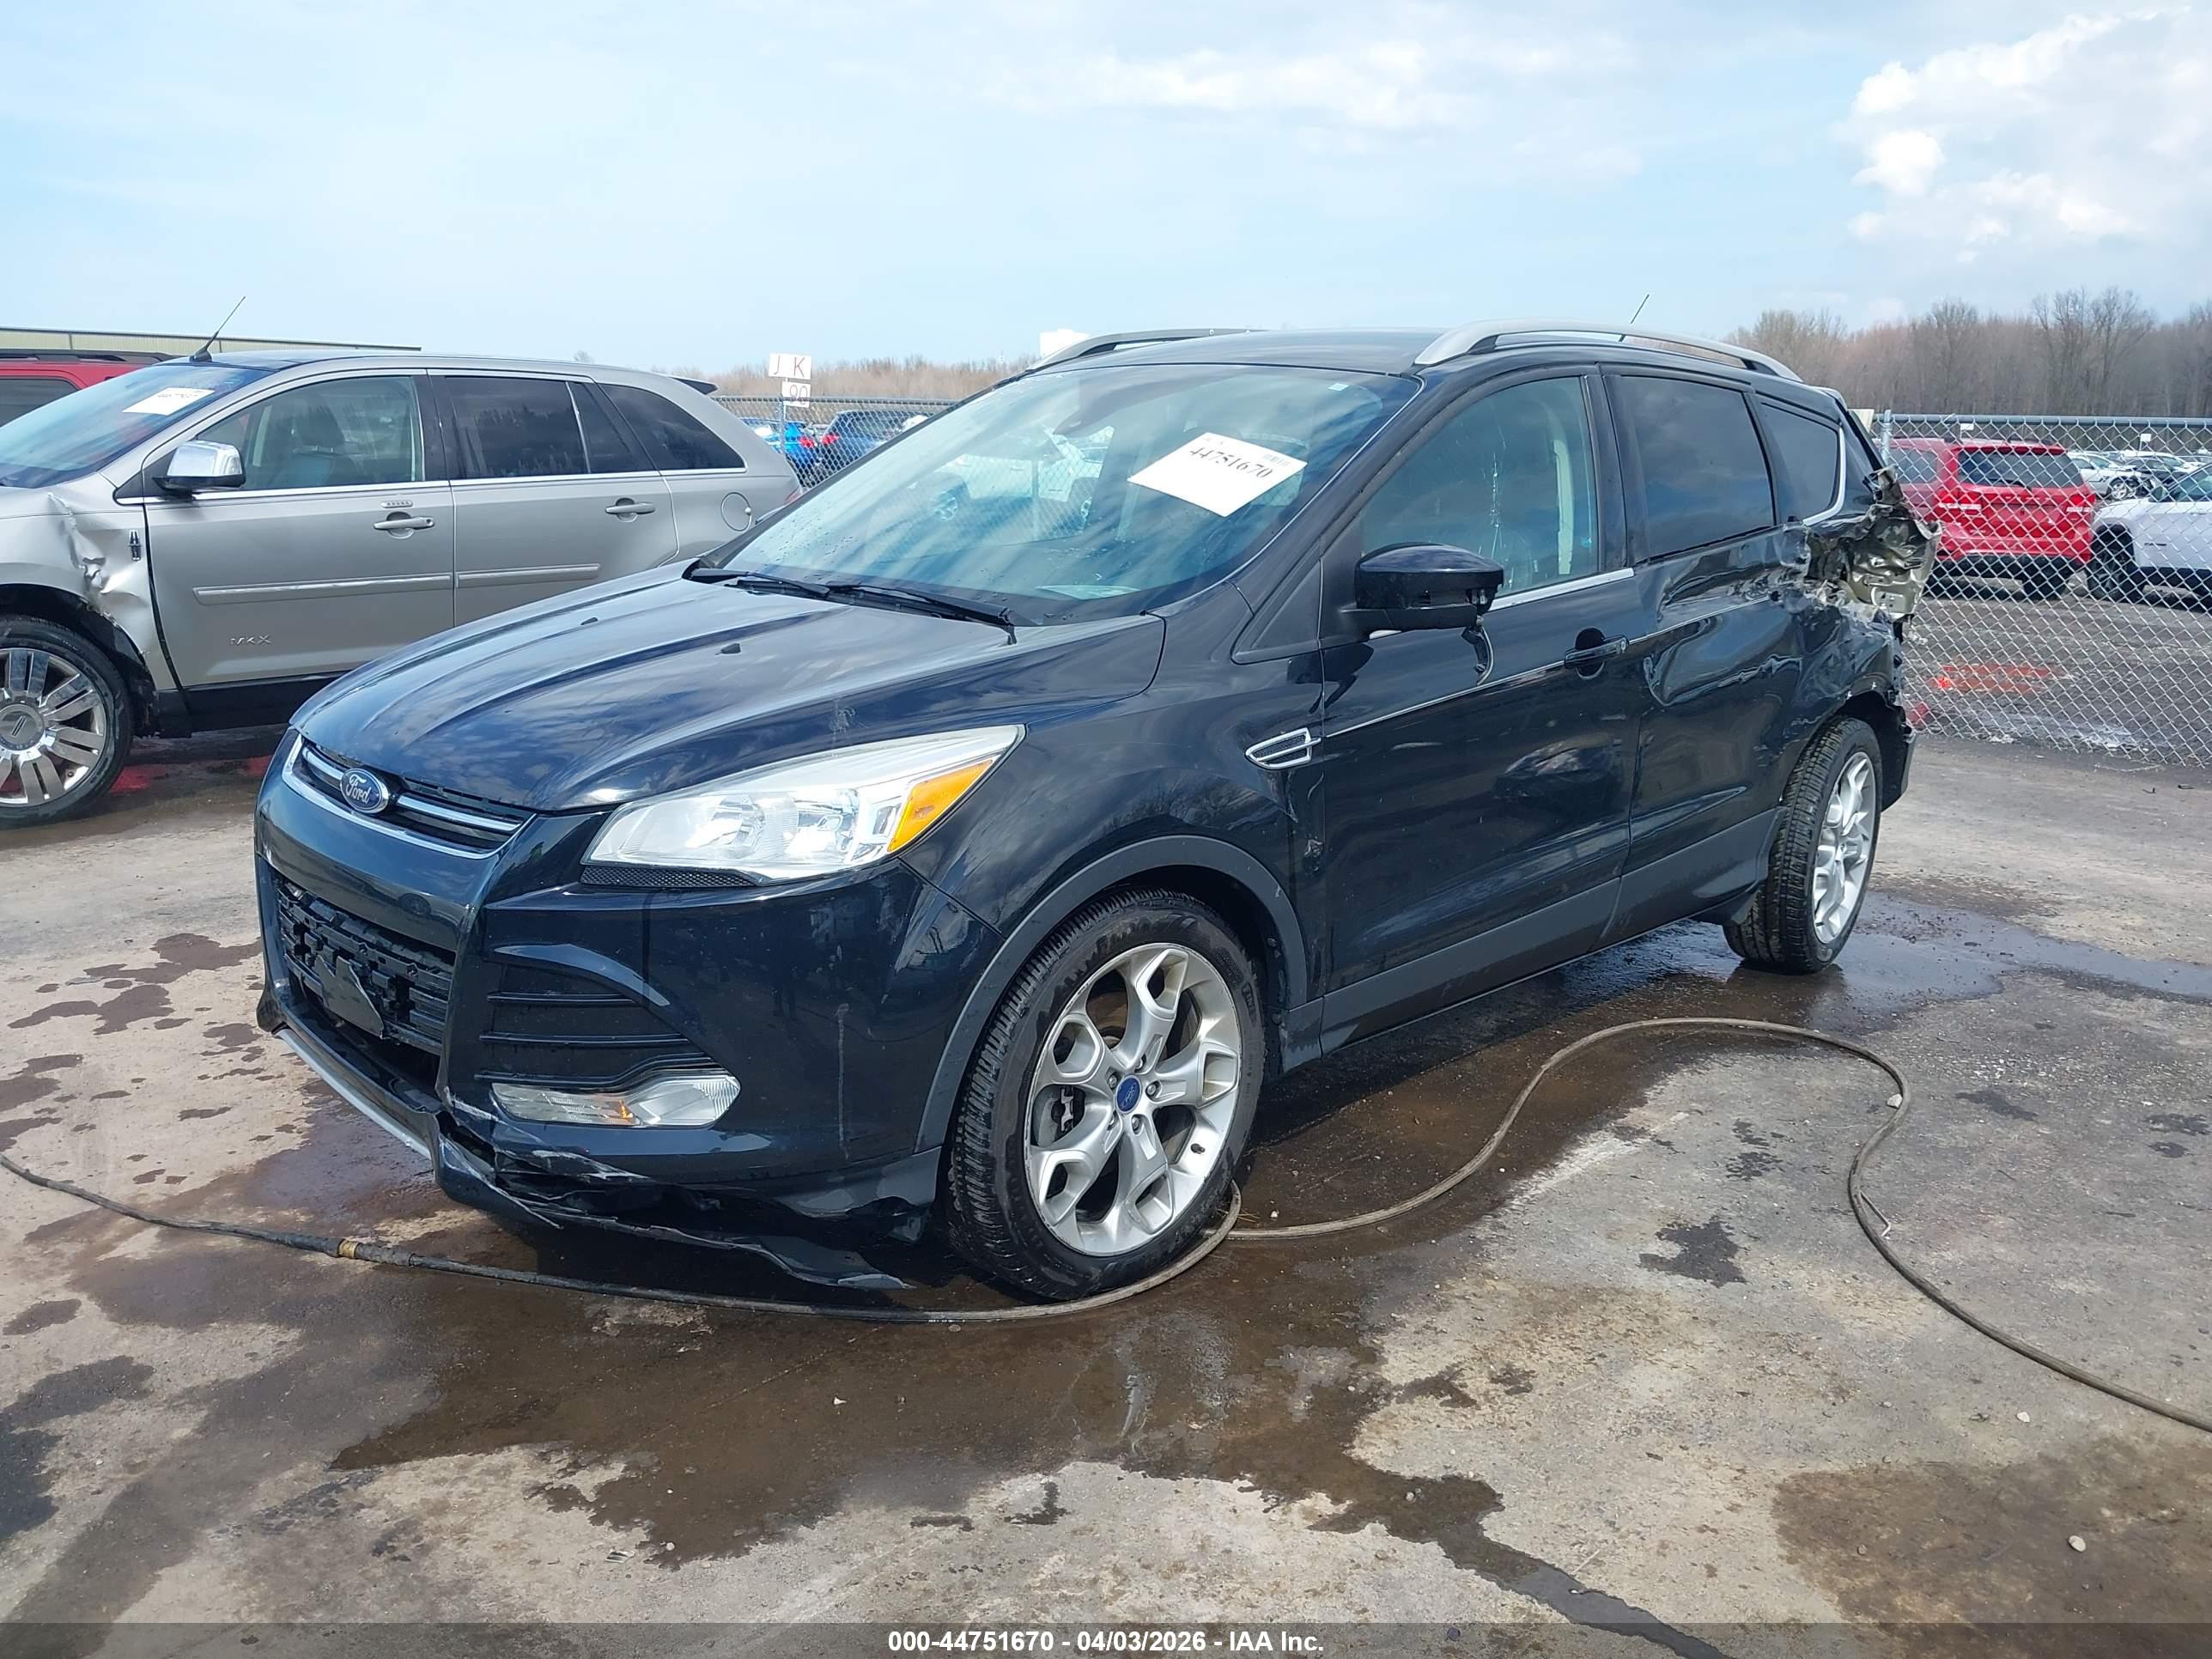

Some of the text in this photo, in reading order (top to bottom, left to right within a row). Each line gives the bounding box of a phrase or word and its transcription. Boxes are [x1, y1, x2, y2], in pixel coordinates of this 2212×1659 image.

[773, 355, 806, 379] J K
[1189, 446, 1274, 479] 44751670
[345, 773, 373, 805] Ford
